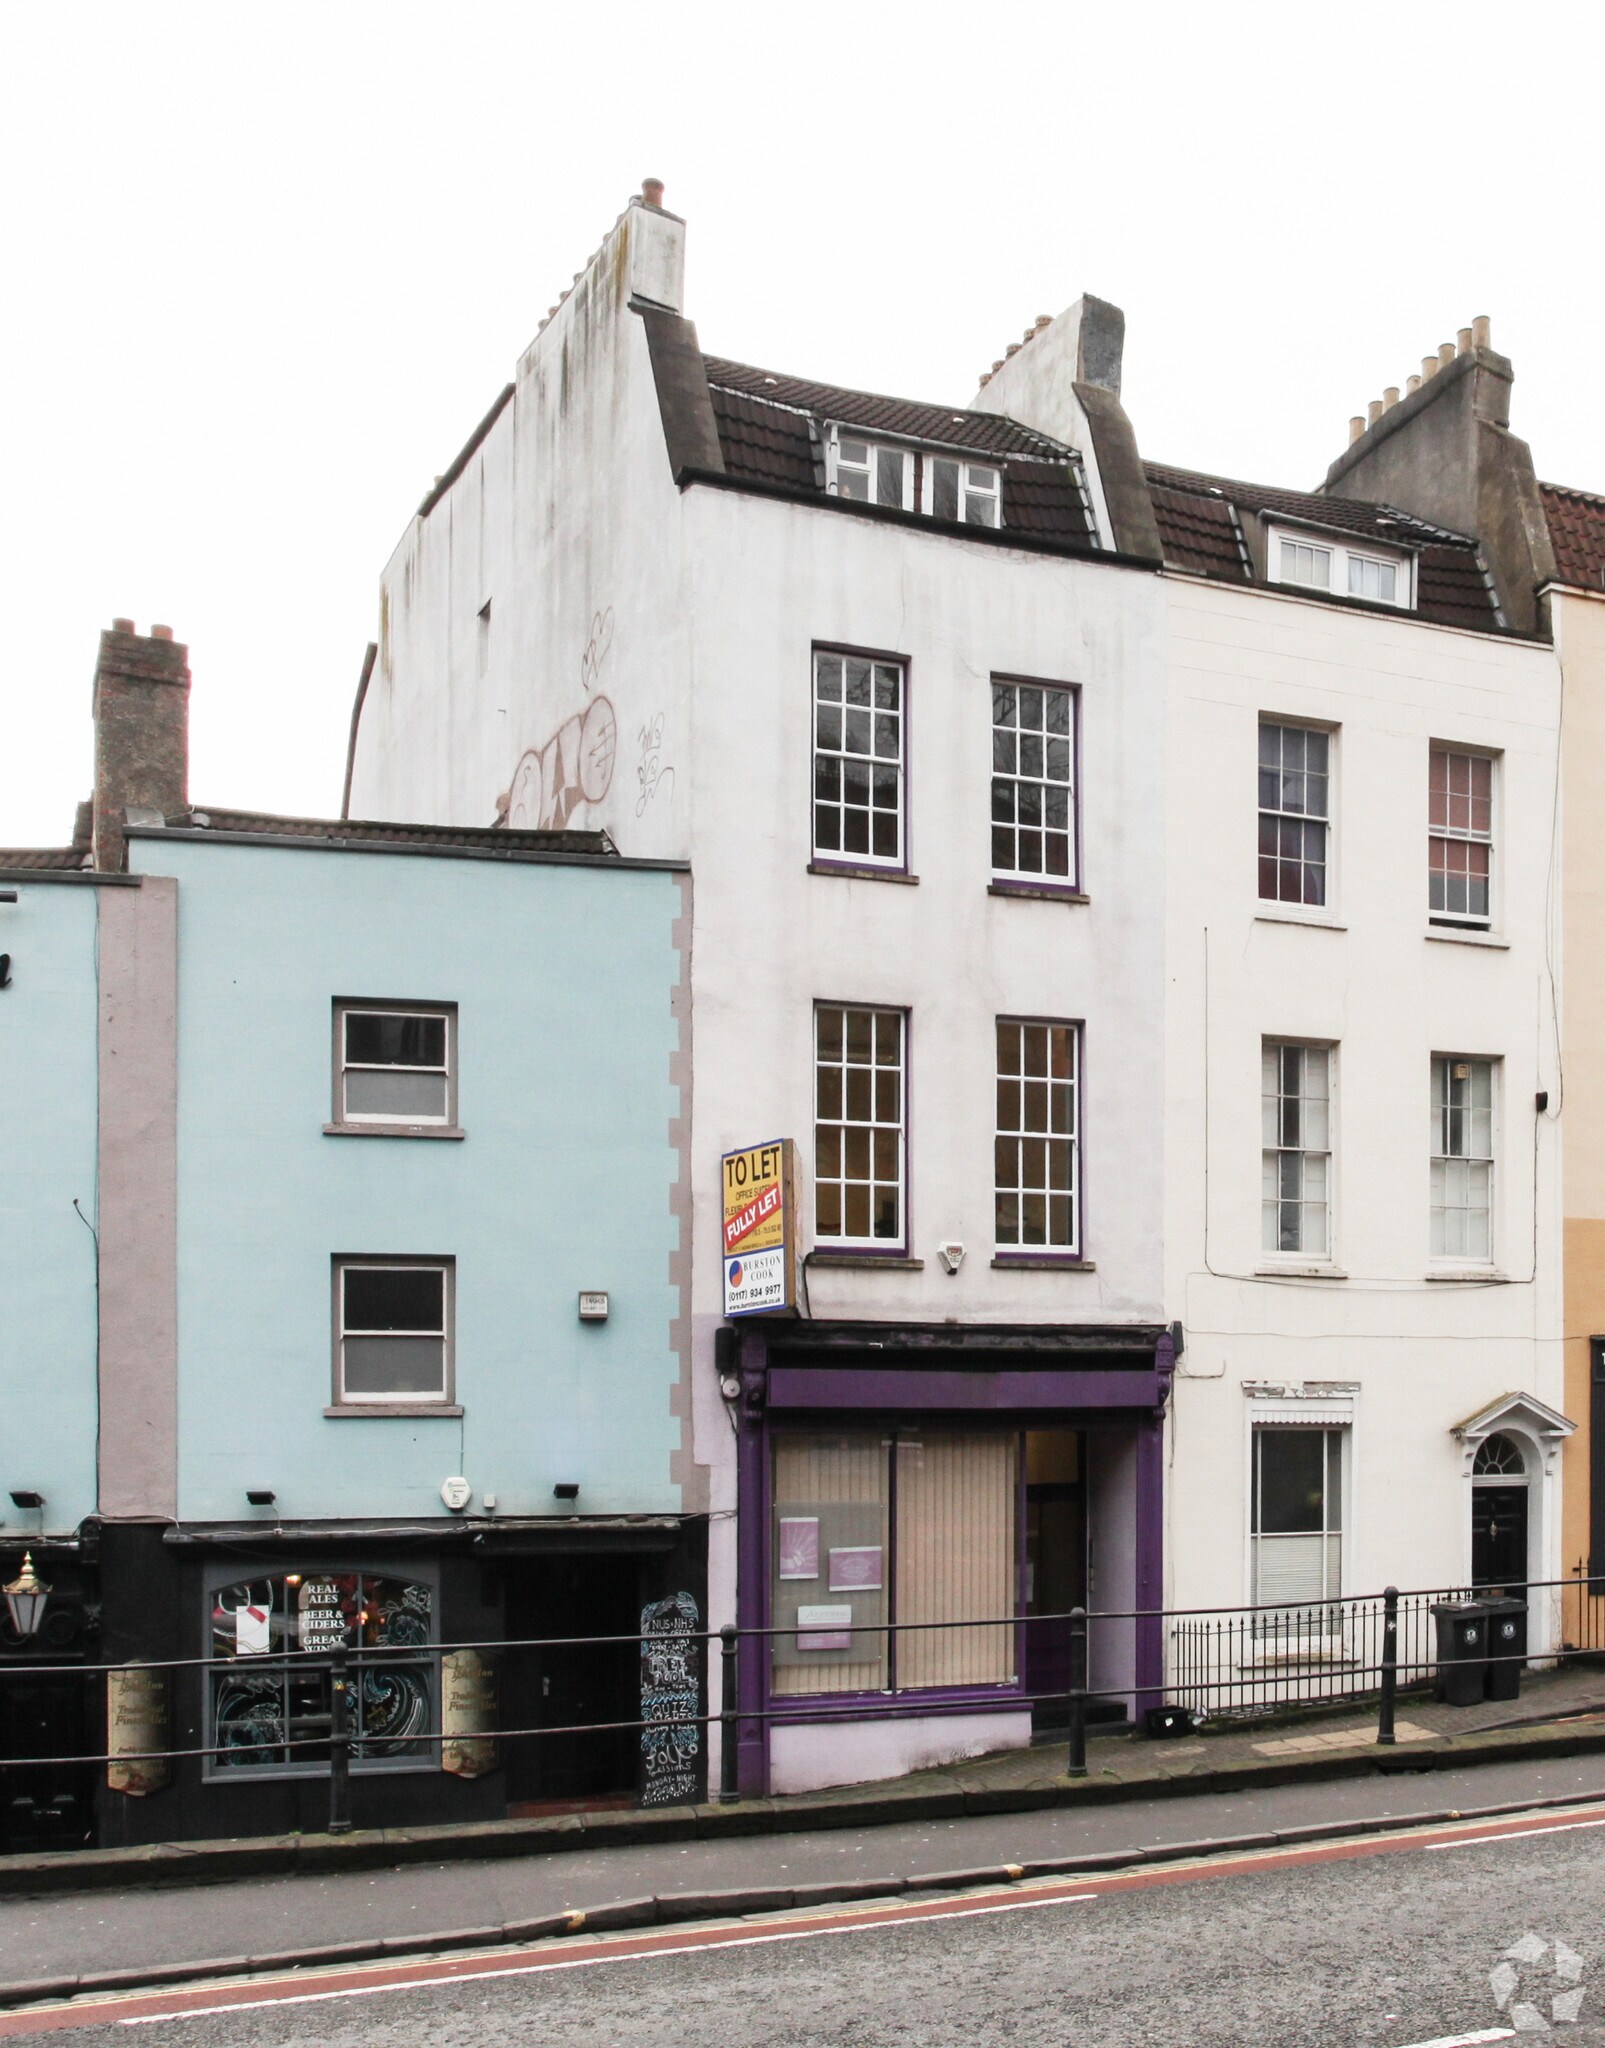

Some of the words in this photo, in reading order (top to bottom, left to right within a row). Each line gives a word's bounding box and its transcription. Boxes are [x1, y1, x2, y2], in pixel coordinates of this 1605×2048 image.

[725, 1156, 747, 1188] TO
[751, 1146, 780, 1182] LET
[726, 1204, 757, 1241] FULLY
[758, 1188, 778, 1216] LET
[743, 1255, 782, 1272] BURSTON
[750, 1268, 774, 1281] COOK
[728, 1289, 748, 1302] (0117)
[750, 1287, 763, 1298] 934
[765, 1283, 781, 1296] 9977
[308, 1584, 340, 1594] REAL
[308, 1594, 339, 1604] ALES
[303, 1610, 334, 1620] BEER
[335, 1610, 344, 1619] &
[302, 1619, 345, 1629] CIDERS
[303, 1634, 345, 1645] GREAT
[653, 1669, 691, 1686] POOL
[651, 1701, 689, 1716] QUIZ
